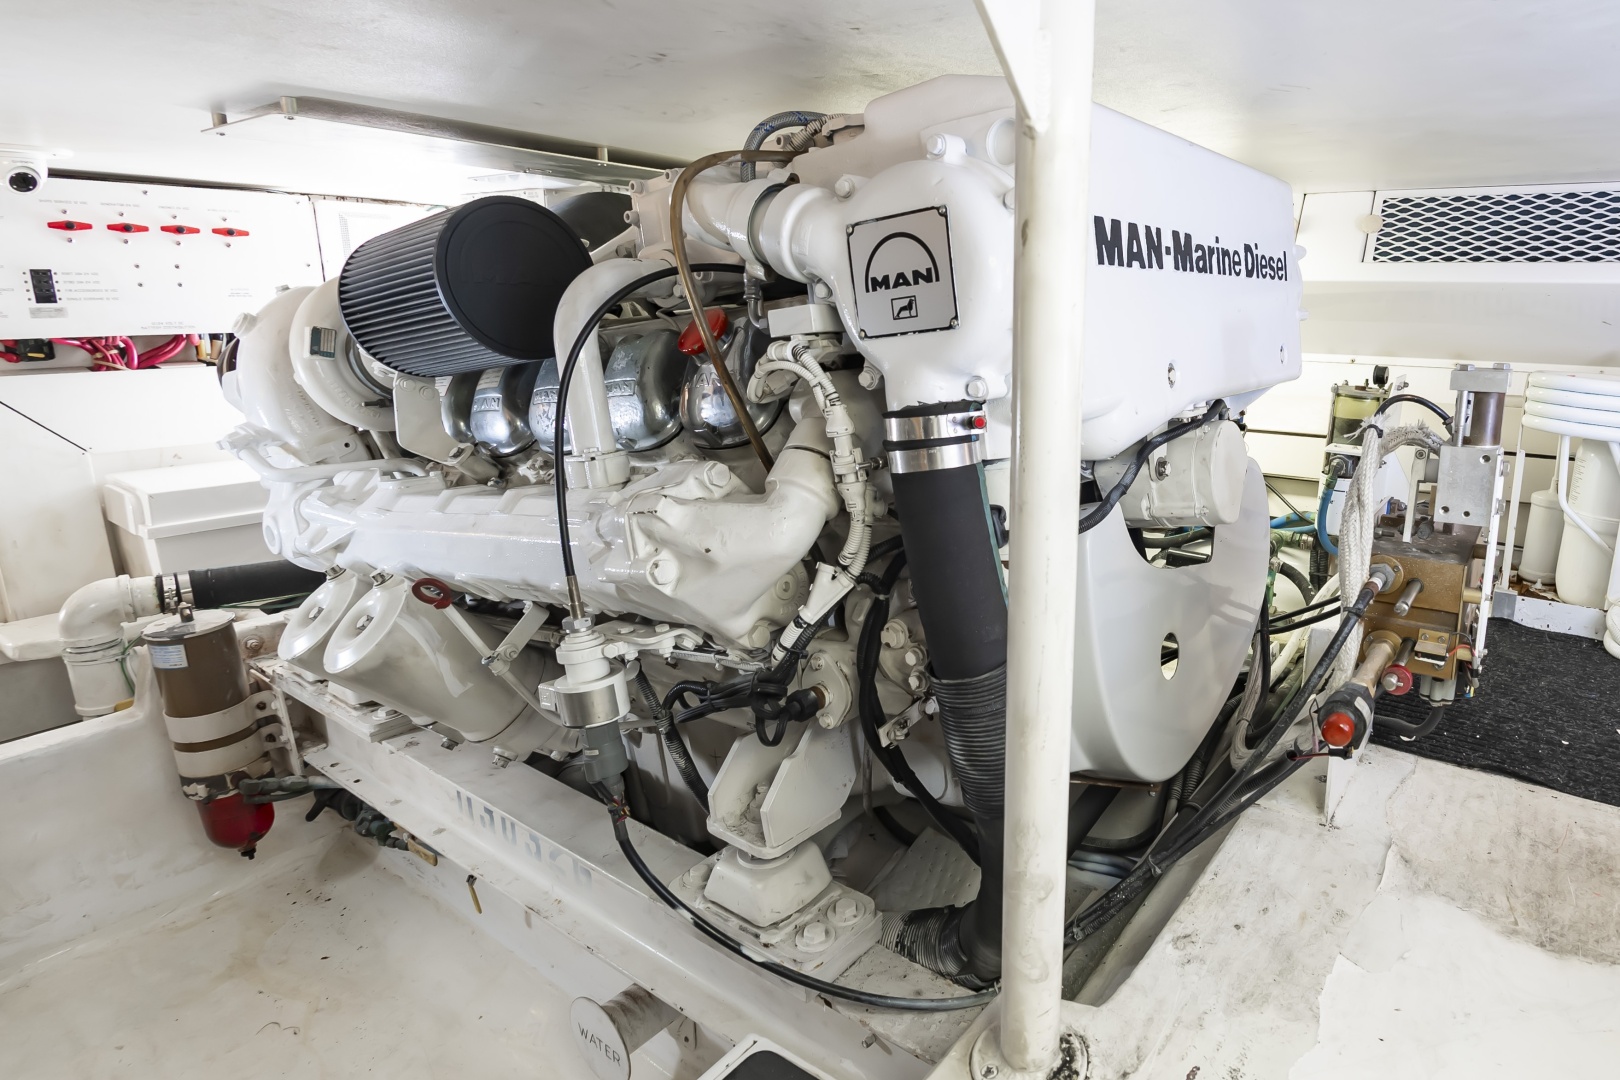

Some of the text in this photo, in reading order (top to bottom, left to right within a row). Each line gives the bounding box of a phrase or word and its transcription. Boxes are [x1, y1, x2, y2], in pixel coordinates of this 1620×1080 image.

[1093, 214, 1288, 282] MAN-Marine Diesel
[870, 266, 934, 293] MAN
[577, 1021, 621, 1067] WATER
